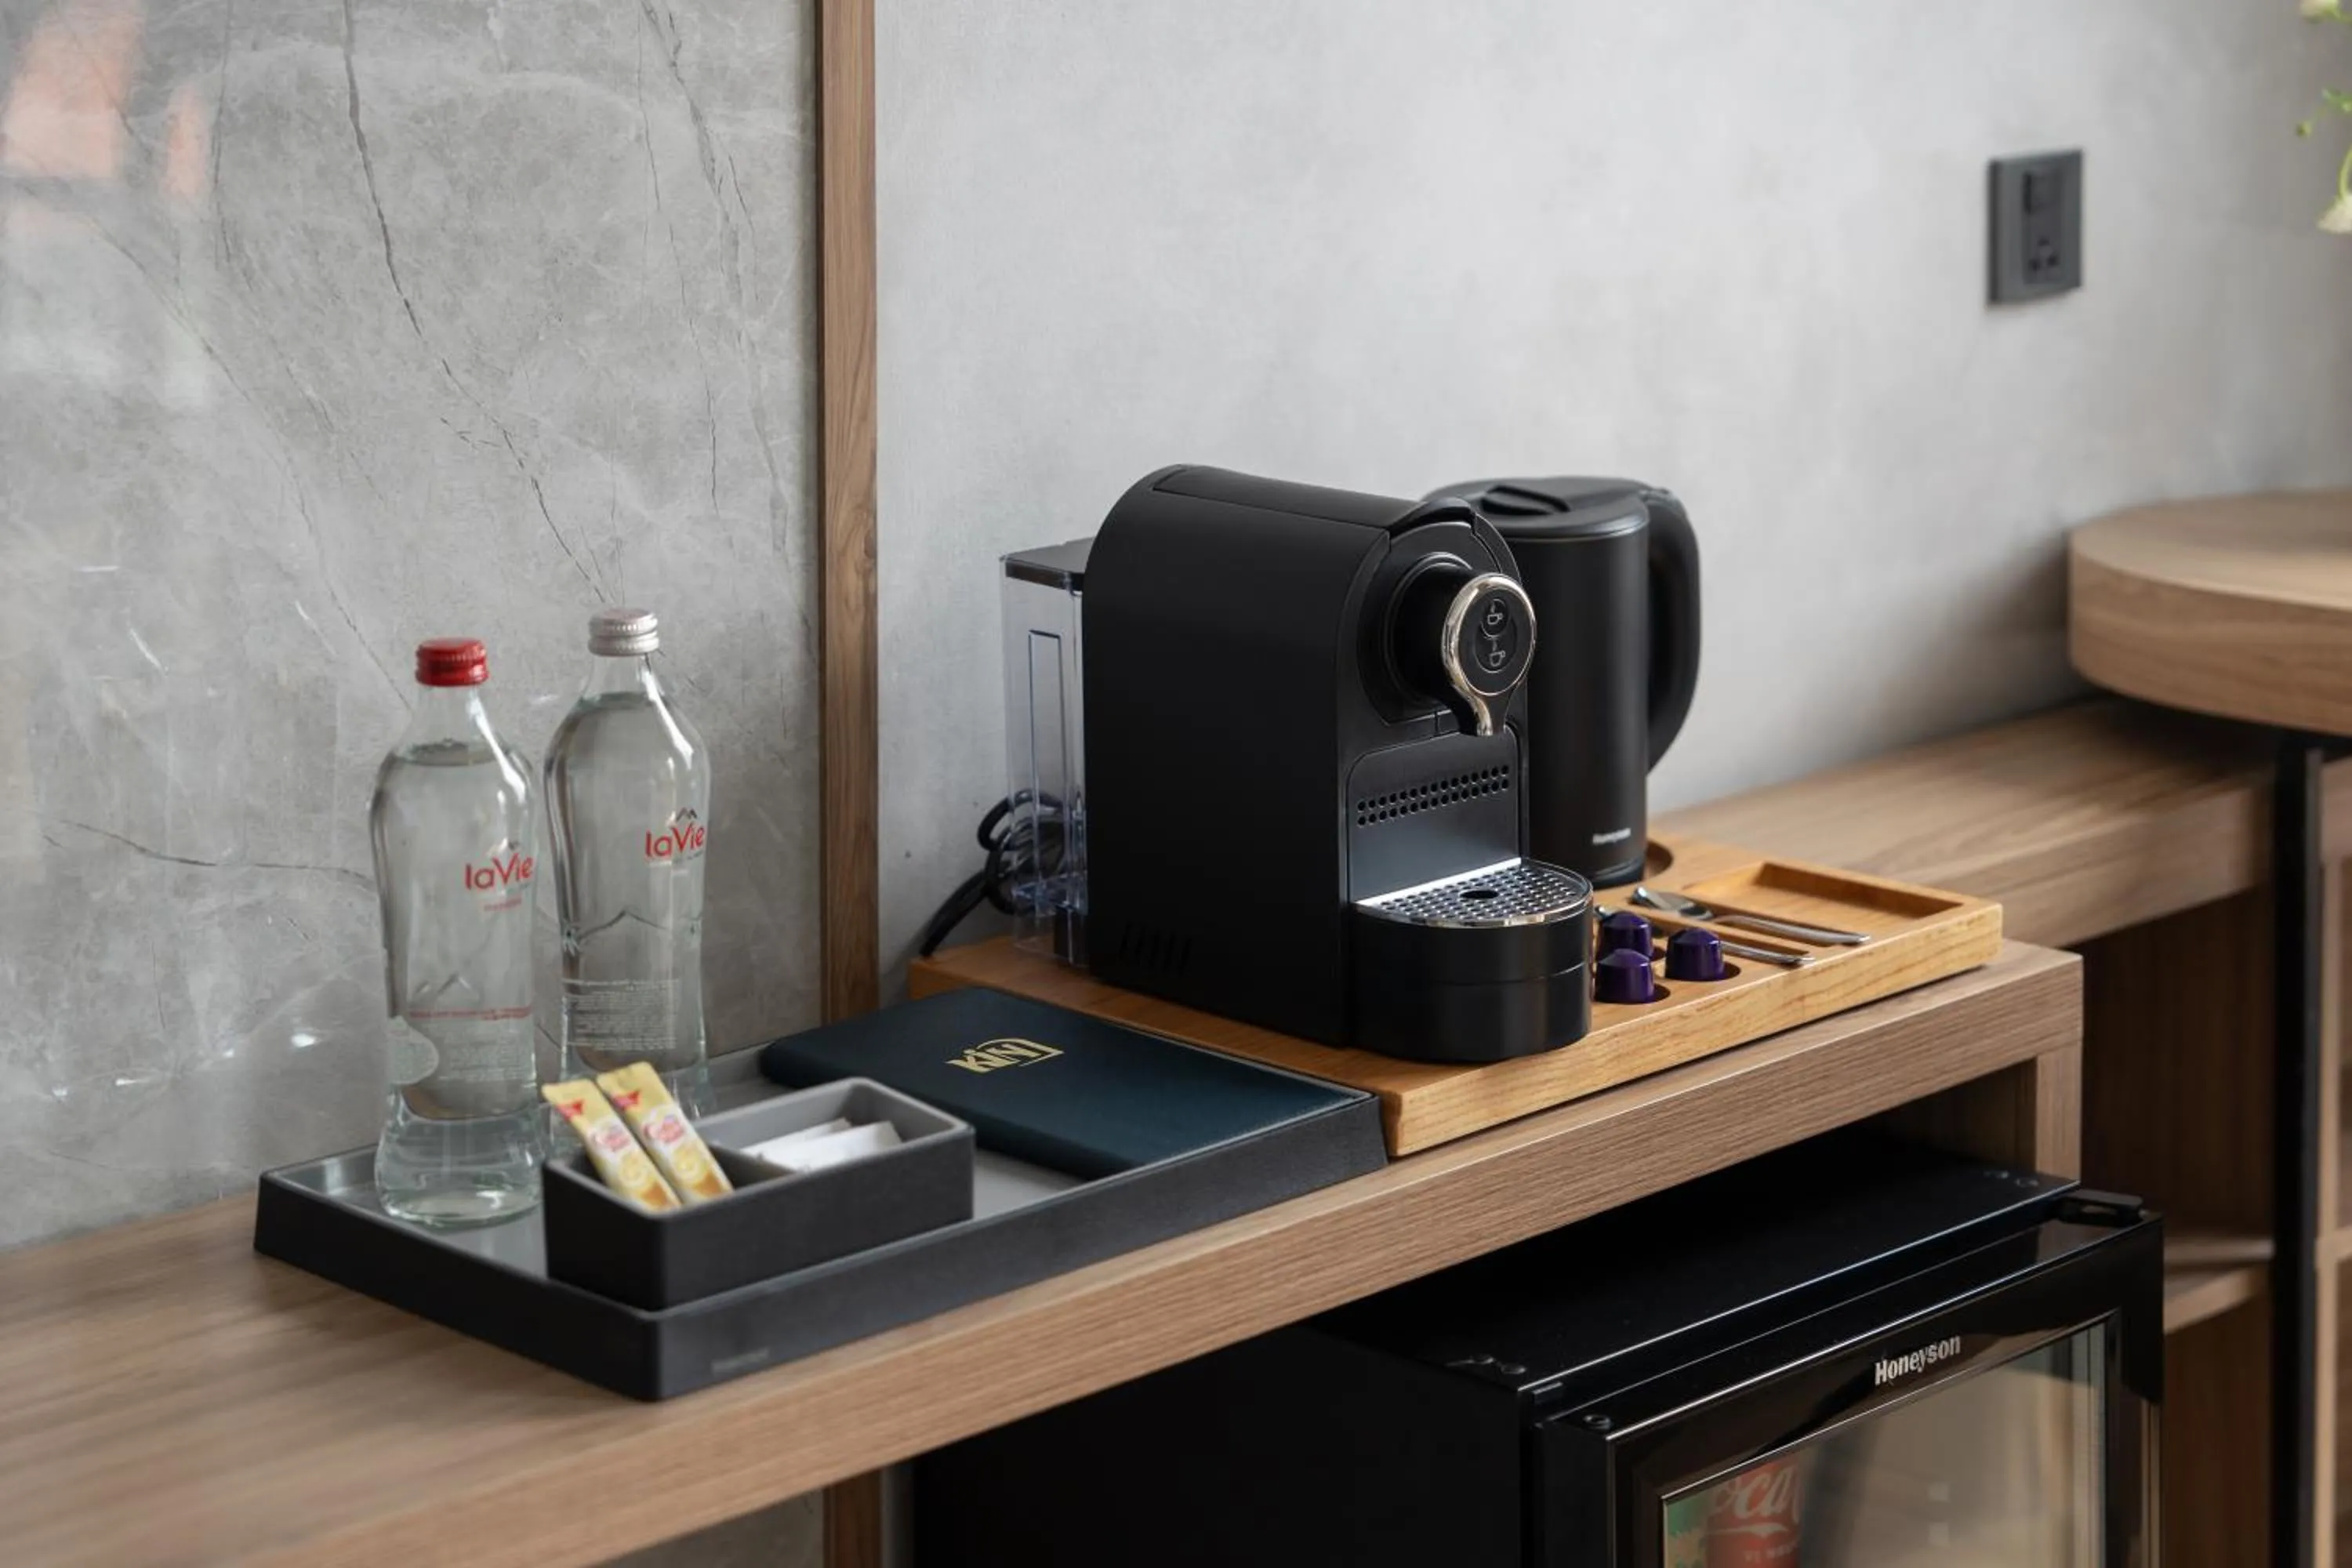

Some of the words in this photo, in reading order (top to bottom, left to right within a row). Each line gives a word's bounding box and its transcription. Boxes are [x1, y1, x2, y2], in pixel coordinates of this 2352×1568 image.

[645, 822, 705, 858] laVie
[465, 852, 533, 890] laVie
[1875, 1336, 1961, 1386] Honeyson
